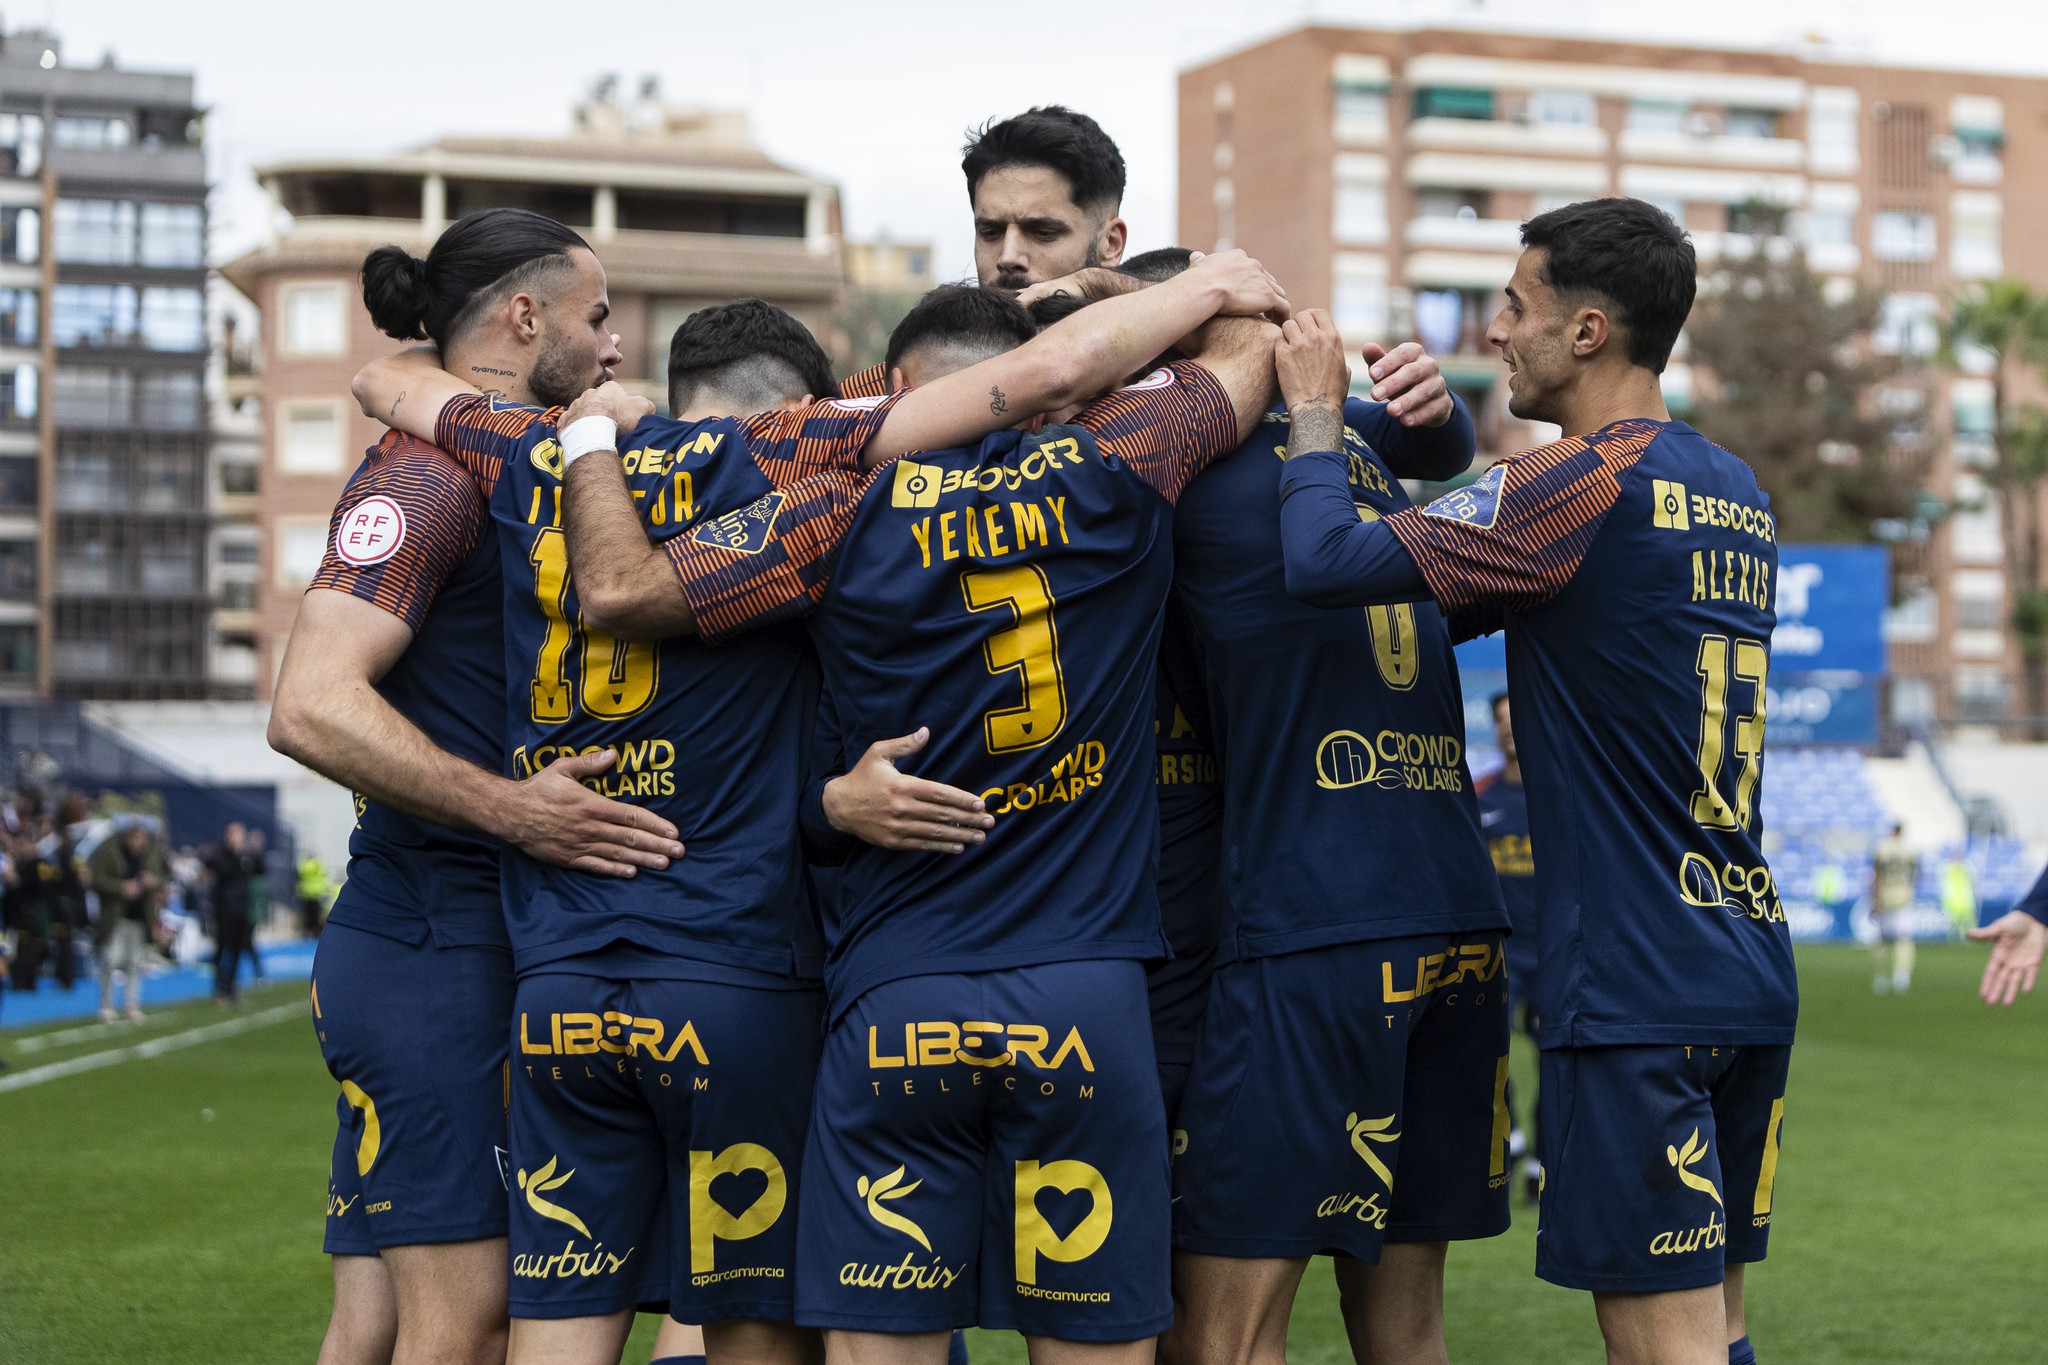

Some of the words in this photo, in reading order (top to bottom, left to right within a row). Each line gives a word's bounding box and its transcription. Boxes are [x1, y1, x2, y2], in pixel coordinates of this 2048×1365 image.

[941, 437, 1085, 493] BEOCCER
[911, 496, 1069, 568] YEREMY
[1692, 549, 1769, 610] ALEXIS
[960, 561, 1068, 755] 3
[1376, 730, 1461, 767] CROWD
[1689, 634, 1768, 833] 17
[581, 771, 676, 797] OLARIS
[1404, 763, 1462, 793] SOLARIS
[520, 1011, 710, 1065] LIBERA
[869, 1021, 1095, 1072] LIBERA
[692, 1267, 785, 1287] aparcamurcia
[1016, 1284, 1110, 1303] aparcamurcia
